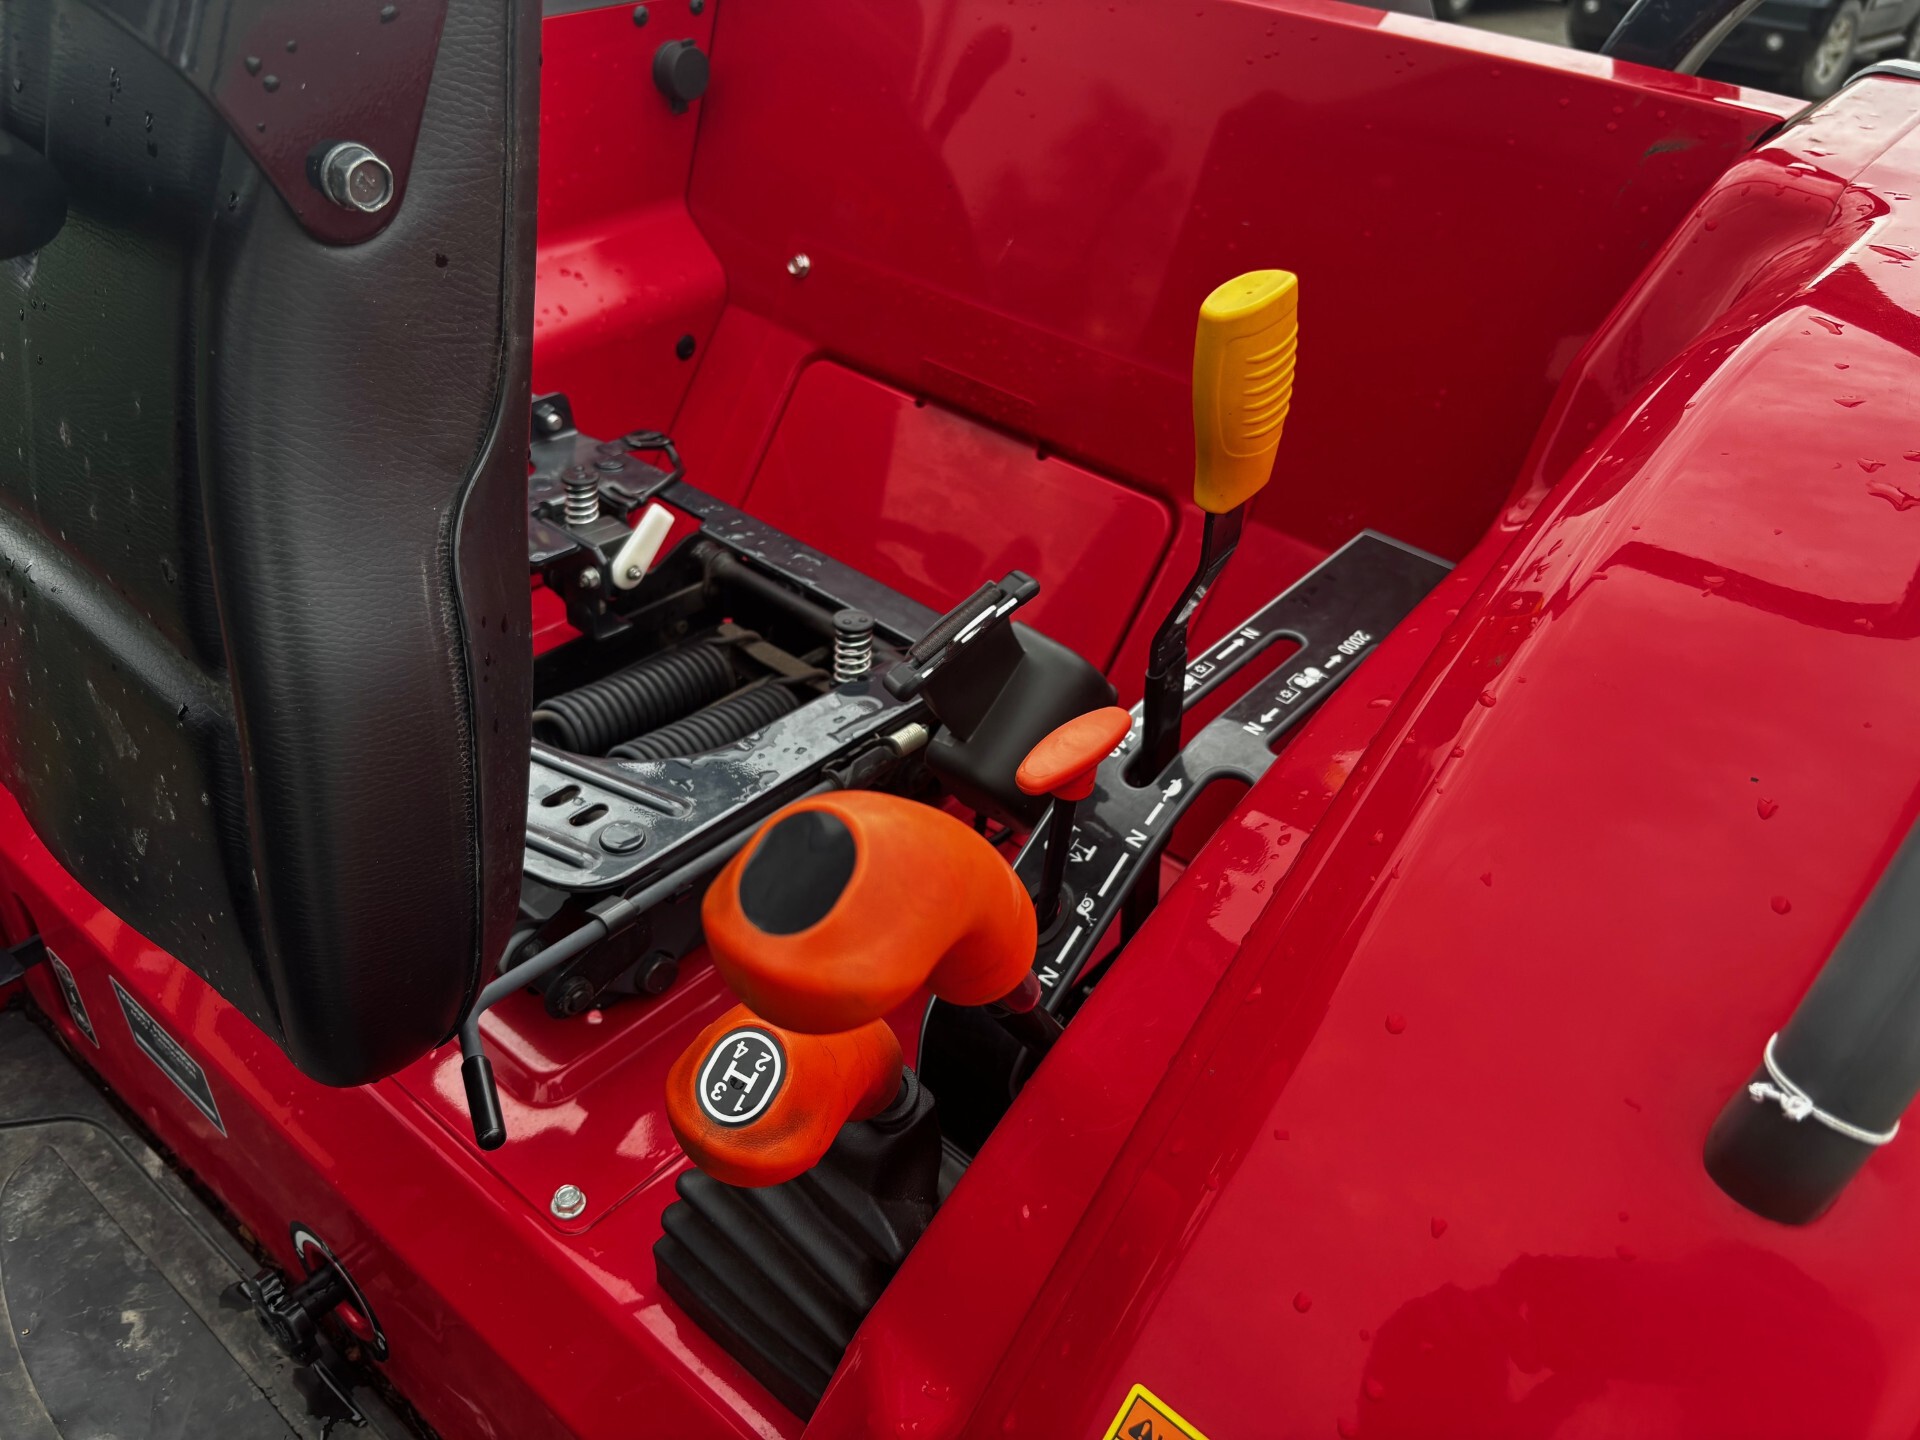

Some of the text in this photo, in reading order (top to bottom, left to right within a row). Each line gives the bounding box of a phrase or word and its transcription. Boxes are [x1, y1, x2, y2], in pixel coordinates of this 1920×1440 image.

[1240, 628, 1260, 640] N
[1338, 630, 1372, 655] 2000
[1242, 722, 1265, 736] N
[1125, 829, 1148, 848] N
[1038, 966, 1060, 987] N
[733, 1040, 749, 1059] 4
[754, 1052, 773, 1072] 2
[710, 1081, 728, 1102] 3
[733, 1094, 746, 1112] 1
